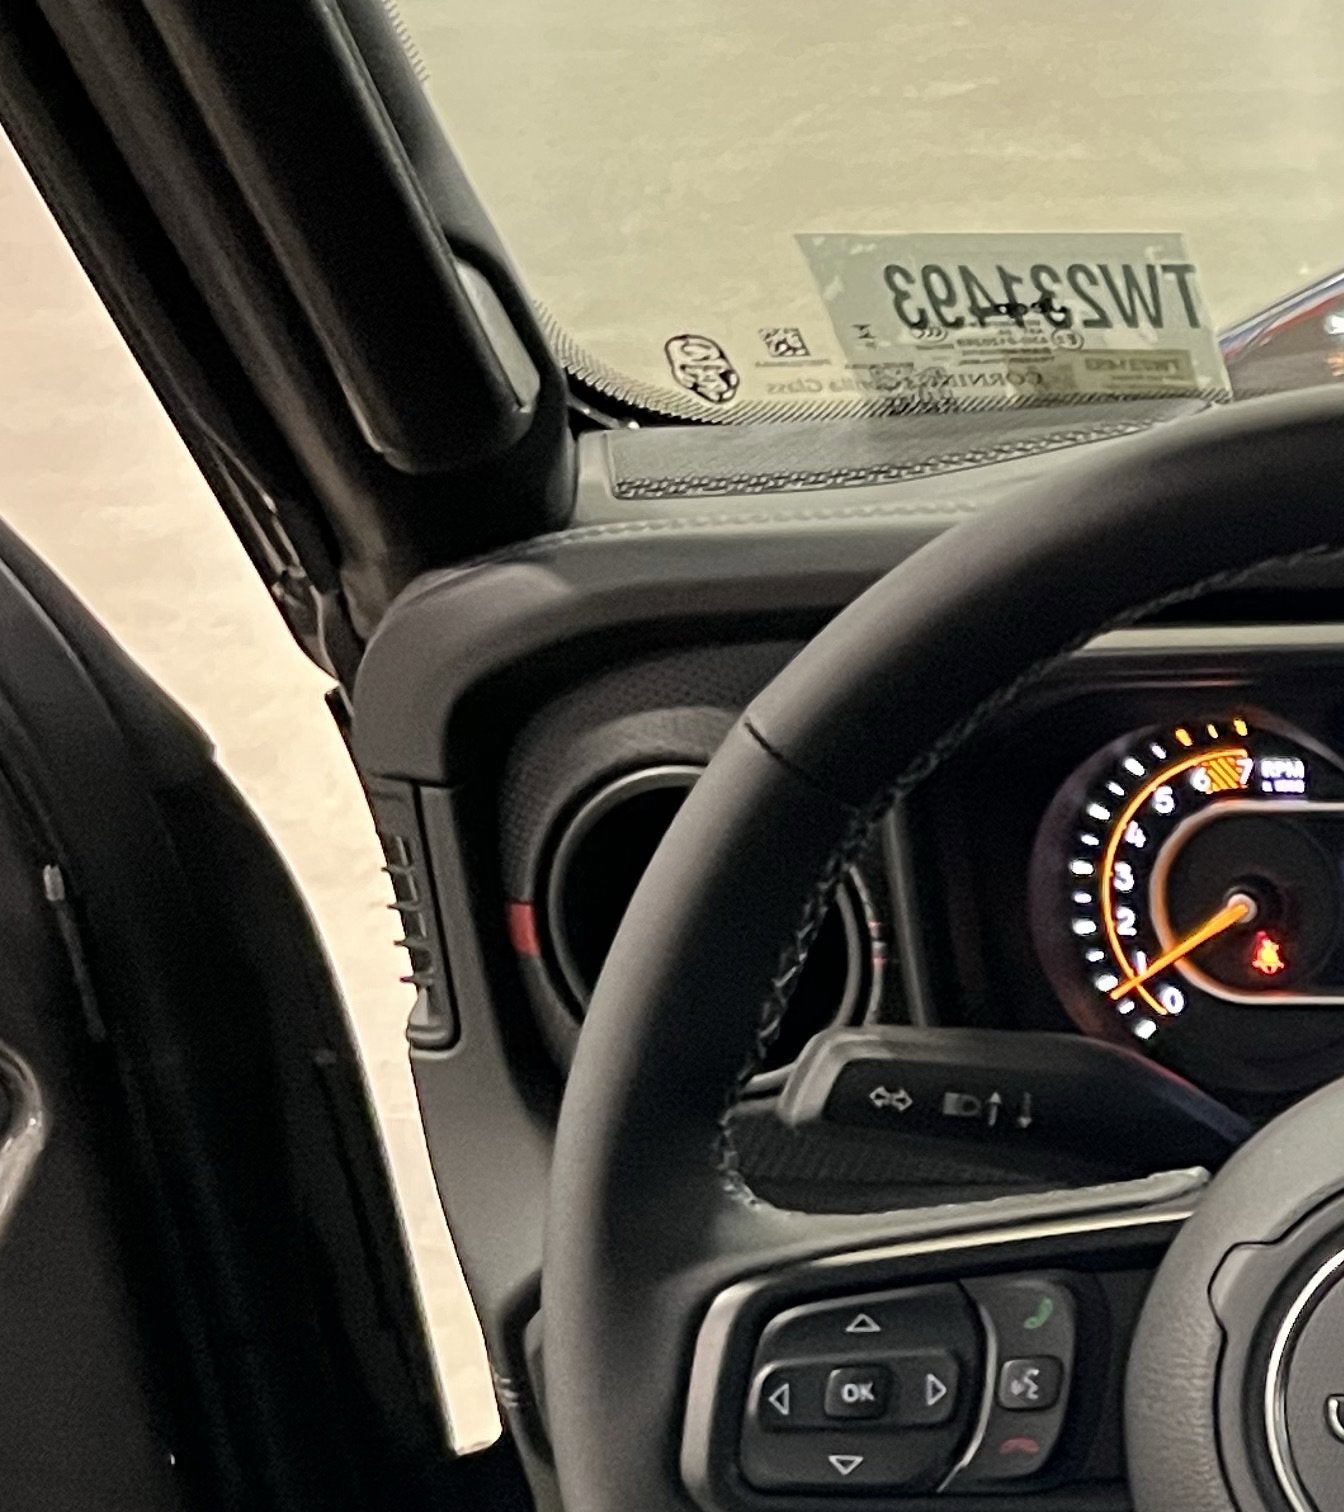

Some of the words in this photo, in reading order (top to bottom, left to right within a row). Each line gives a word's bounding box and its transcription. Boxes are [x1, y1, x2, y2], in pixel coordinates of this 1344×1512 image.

[1190, 767, 1210, 793] 6
[1238, 757, 1253, 789] 7
[1261, 757, 1305, 779] RPM
[1151, 785, 1176, 814] 5
[1124, 820, 1148, 848] 4
[1113, 861, 1135, 892] 3
[1116, 906, 1138, 937] 2
[1158, 984, 1185, 1015] 0
[841, 1382, 877, 1402] OK
